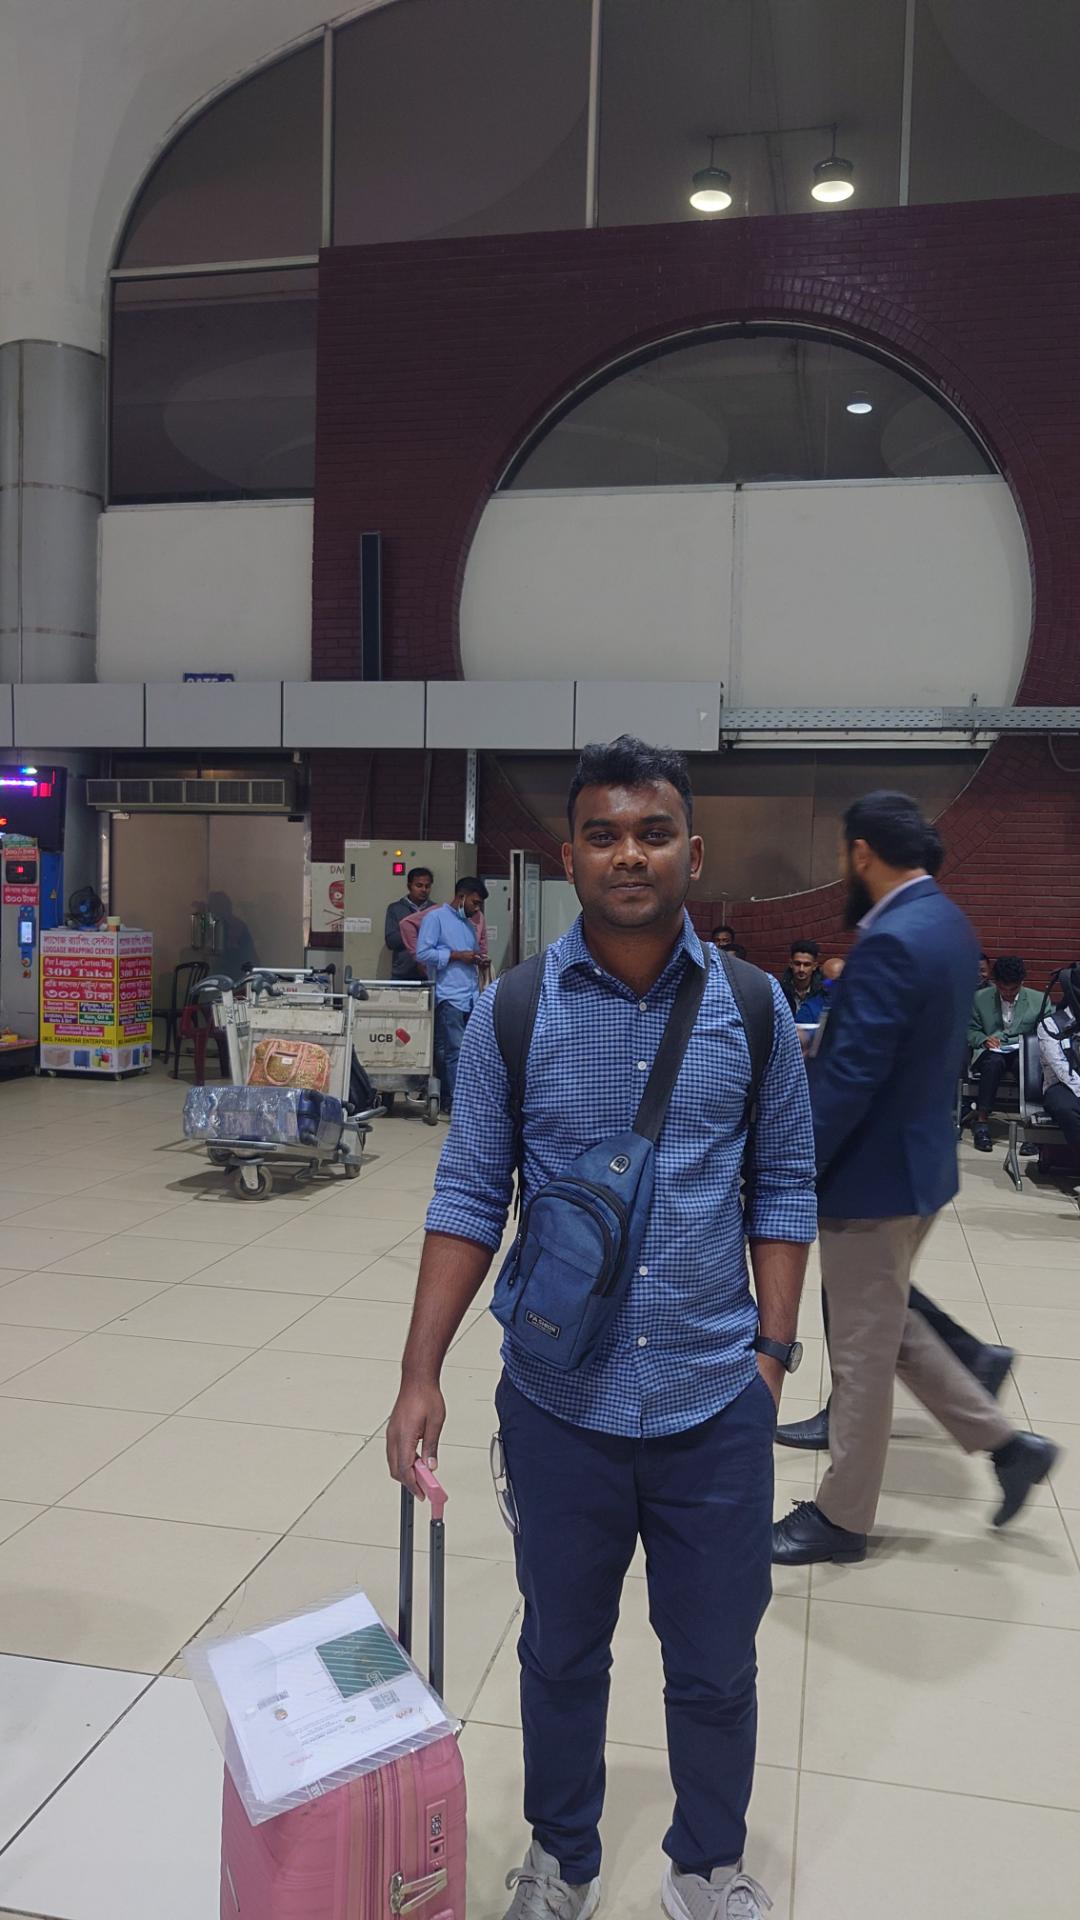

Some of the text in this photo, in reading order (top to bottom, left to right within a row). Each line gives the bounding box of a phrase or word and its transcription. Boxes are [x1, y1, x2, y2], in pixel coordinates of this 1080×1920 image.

[330, 865, 345, 874] DA
[46, 967, 112, 978] 300 Taka
[369, 1033, 393, 1043] UCB
